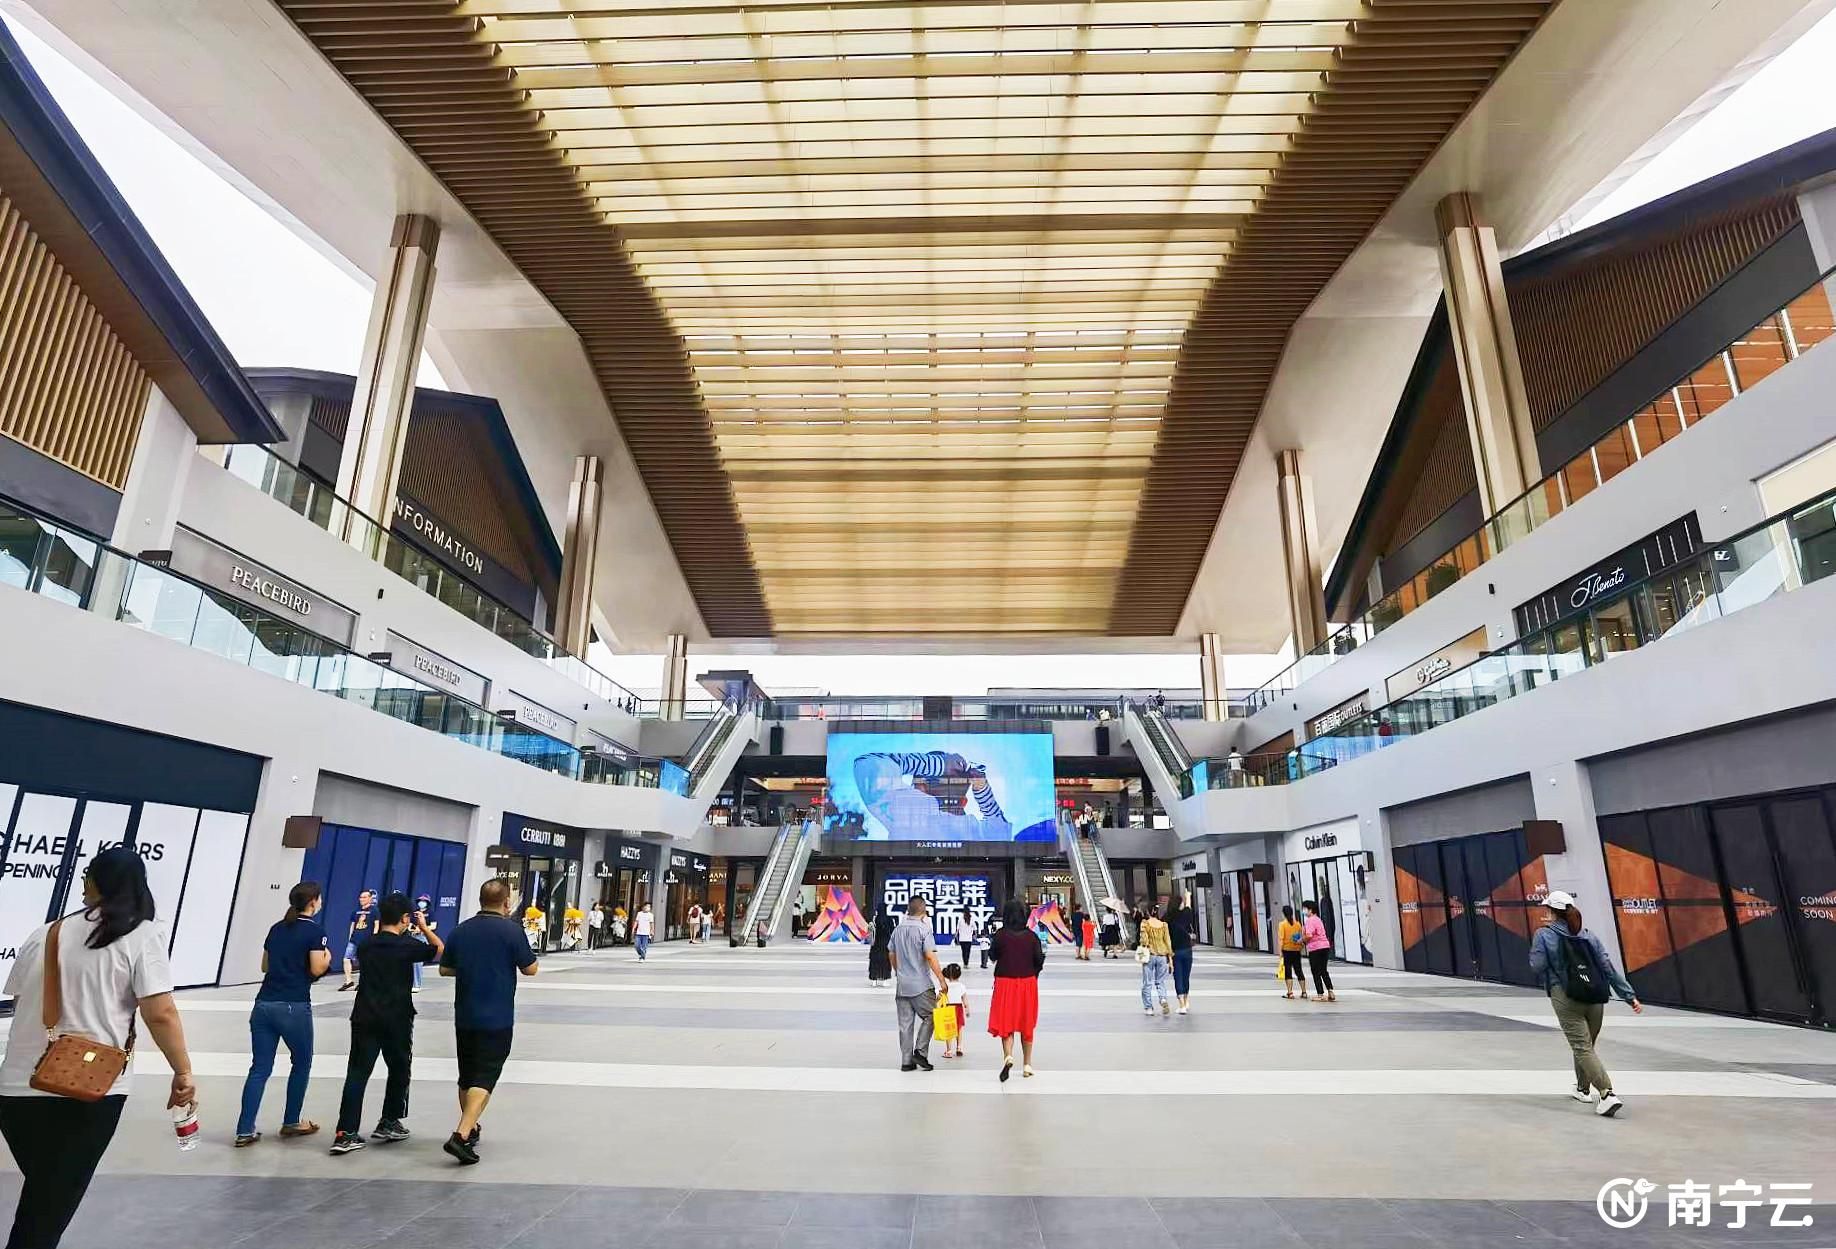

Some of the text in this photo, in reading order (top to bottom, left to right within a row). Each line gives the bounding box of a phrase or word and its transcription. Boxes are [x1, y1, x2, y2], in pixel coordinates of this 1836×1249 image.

[394, 496, 483, 574] NFORMATION
[231, 566, 312, 615] PEACEBIRD
[415, 655, 462, 686] PEACEBIRD
[1340, 702, 1363, 722] OUTLETS
[521, 827, 551, 845] CERRUTI
[620, 846, 641, 860] HAZZYS
[884, 879, 987, 906] 品质奥莱
[1804, 909, 1834, 919] SOON
